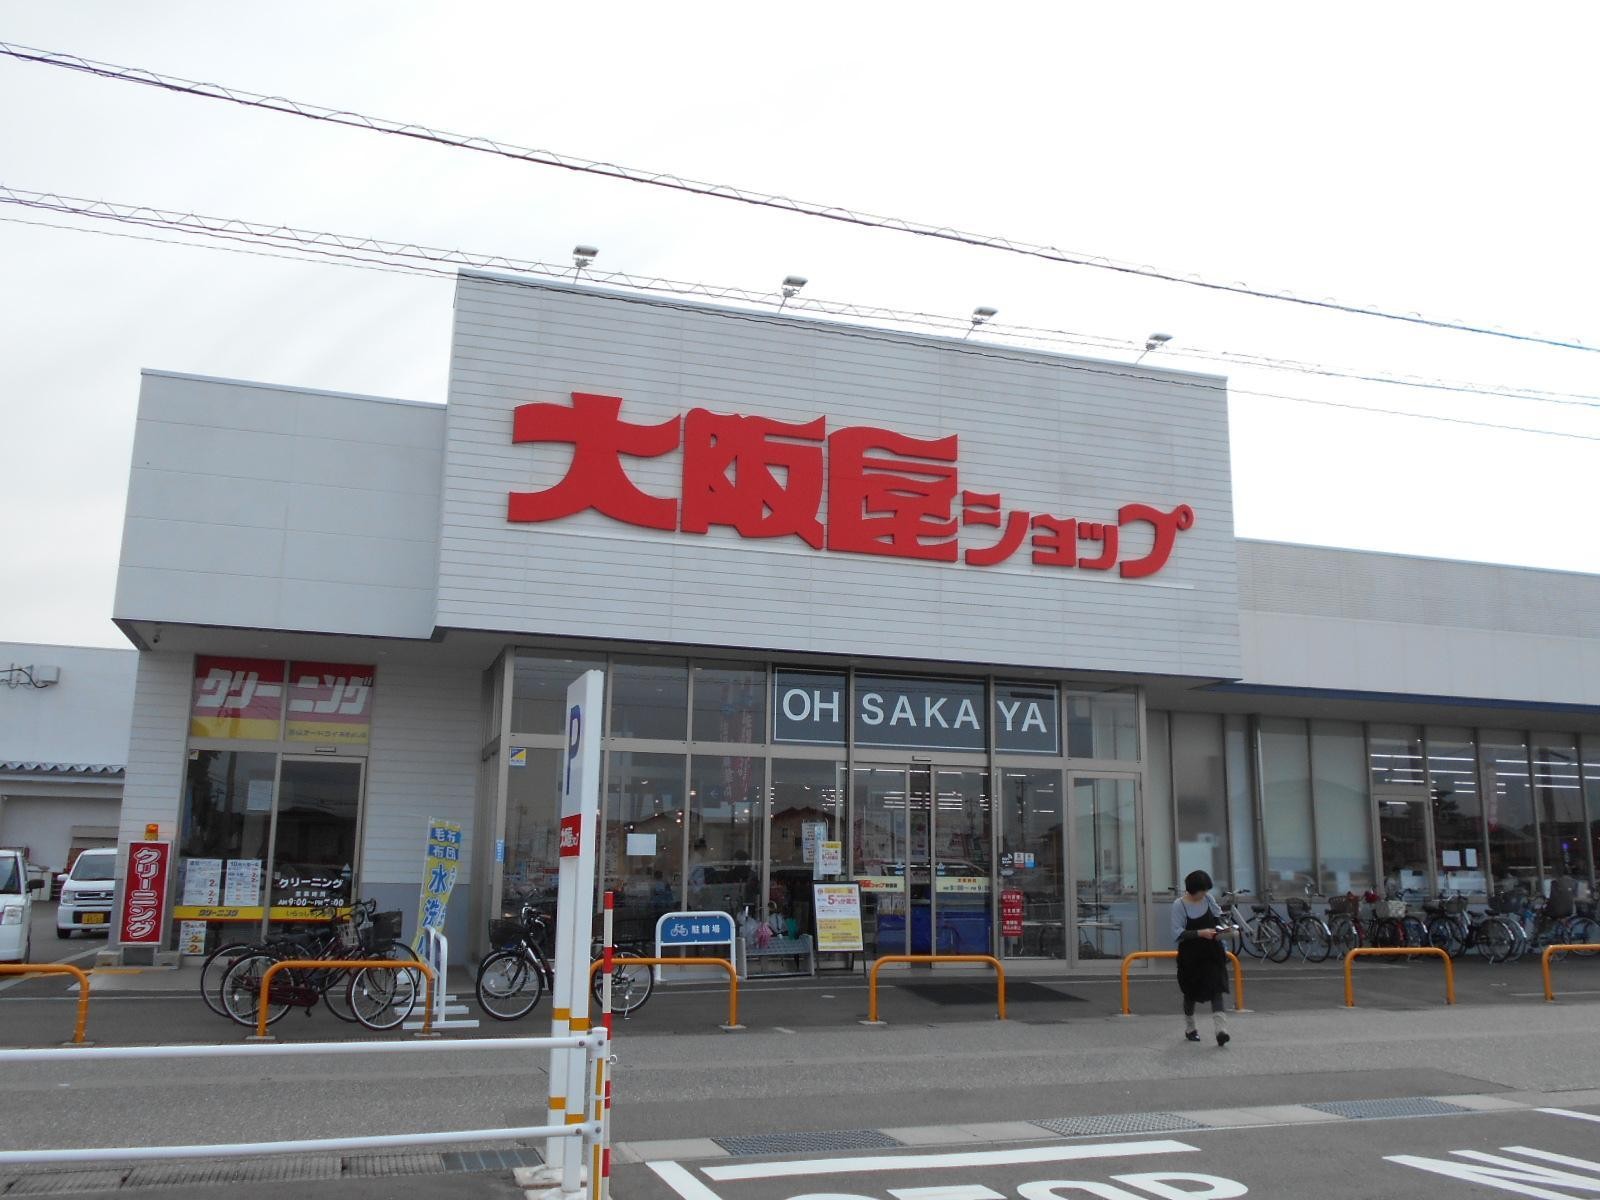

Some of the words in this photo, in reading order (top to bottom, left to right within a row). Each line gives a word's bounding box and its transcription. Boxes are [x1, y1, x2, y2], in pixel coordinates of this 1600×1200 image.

[508, 392, 1195, 578] 大阪屋ショップ
[197, 668, 373, 715] クリーニング
[782, 688, 840, 723] OH
[565, 704, 581, 796] P
[434, 828, 457, 843] 毛布
[127, 848, 161, 939] クリーニング
[279, 877, 344, 889] クリーニング
[691, 924, 720, 935] 駐輪場
